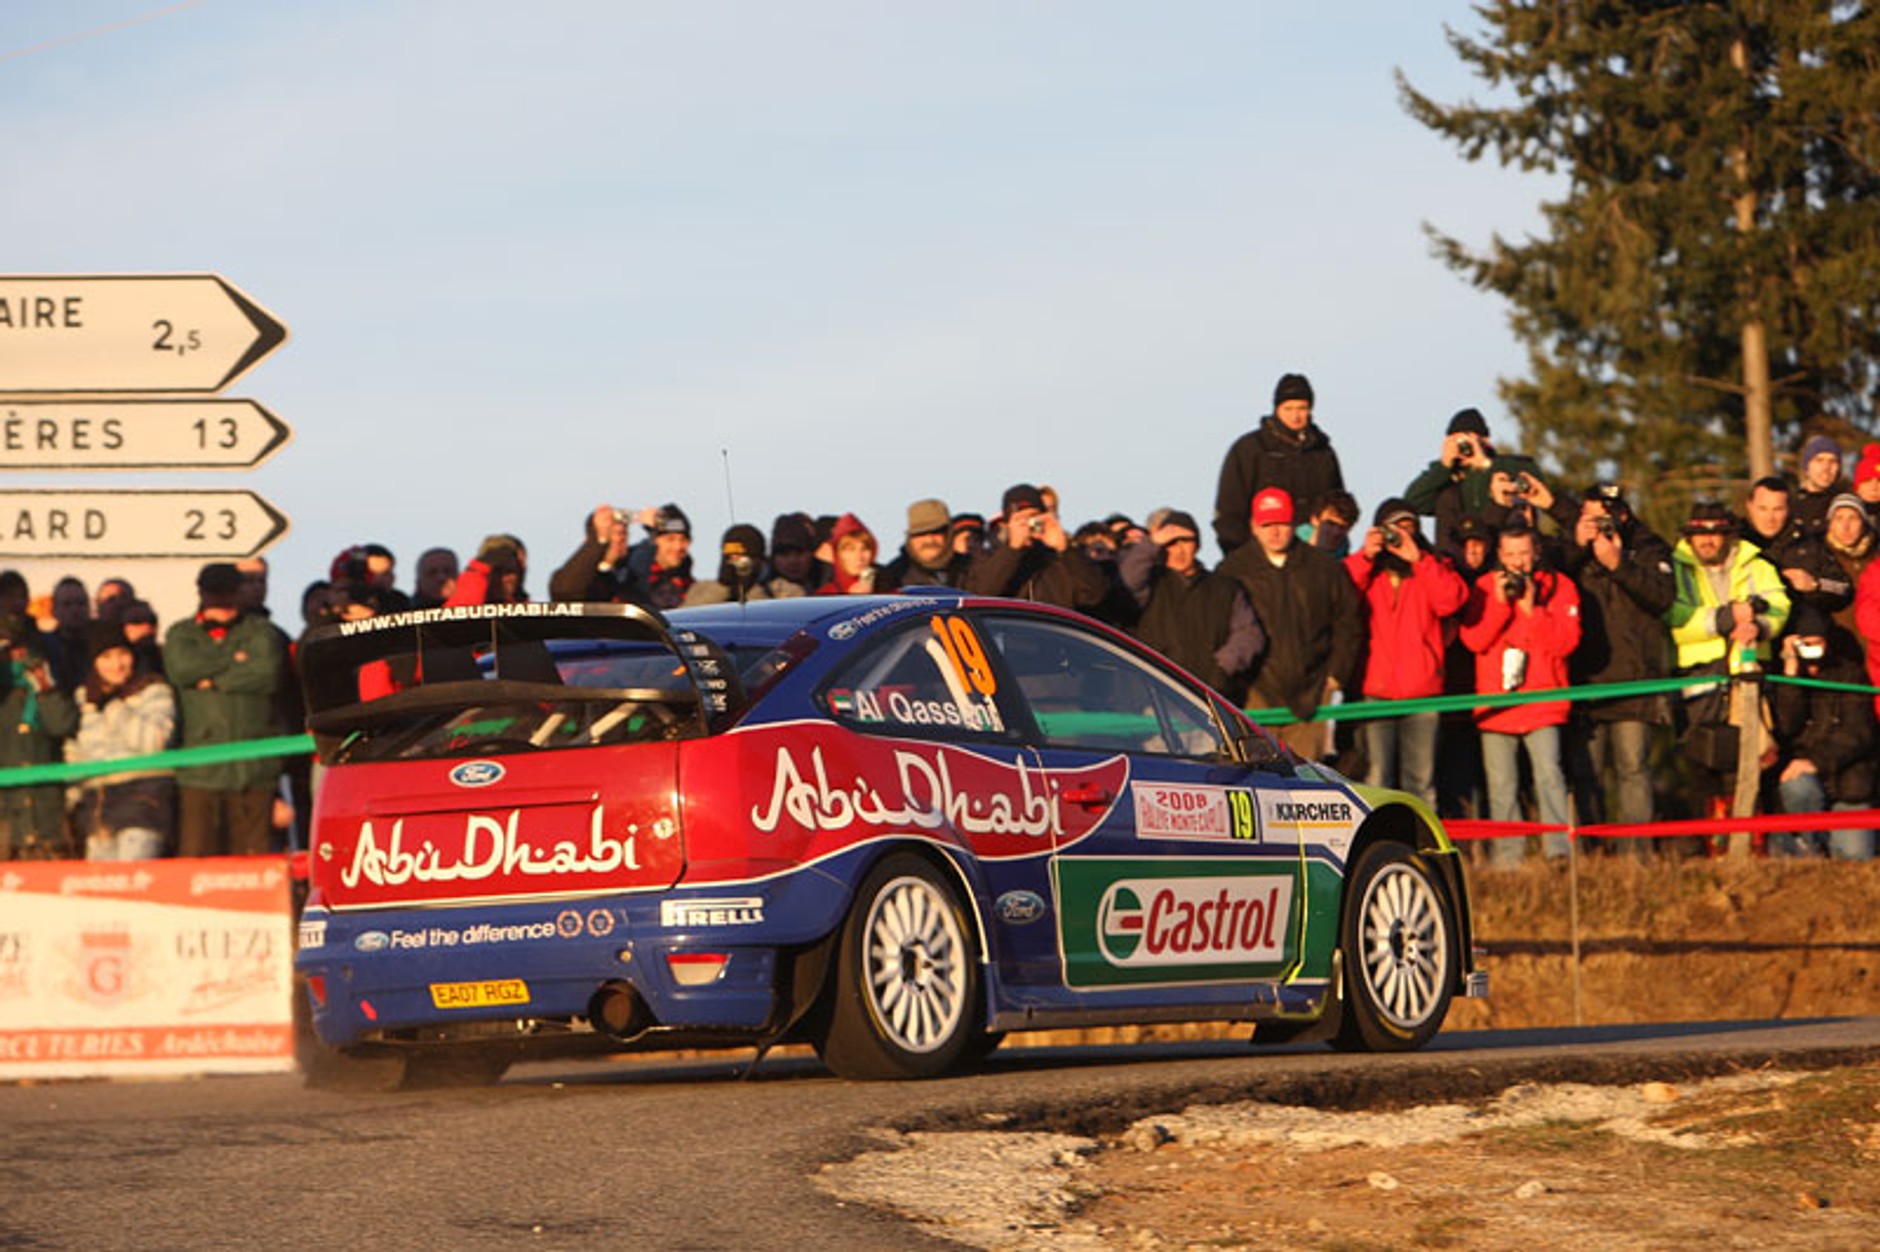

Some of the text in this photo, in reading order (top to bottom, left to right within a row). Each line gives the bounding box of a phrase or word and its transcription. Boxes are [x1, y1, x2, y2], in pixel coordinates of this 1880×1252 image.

[152, 320, 201, 355] 2,5
[193, 418, 238, 448] 13
[0, 509, 237, 540] ARD 23
[340, 603, 584, 636] WWW.VISITABUDHABI.AE
[930, 615, 997, 695] 19
[855, 690, 885, 722] Al
[890, 748, 1065, 836] Dhabi
[1156, 790, 1208, 811] 2008
[1230, 790, 1256, 838] 19
[460, 803, 640, 880] Dhabi
[661, 897, 764, 926] PIRELLI
[1146, 887, 1279, 955] Castrol
[390, 929, 426, 949] Feel
[430, 926, 459, 947] the
[462, 921, 556, 945] difference
[88, 955, 123, 995] G
[436, 981, 523, 1005] EA07 RGZ
